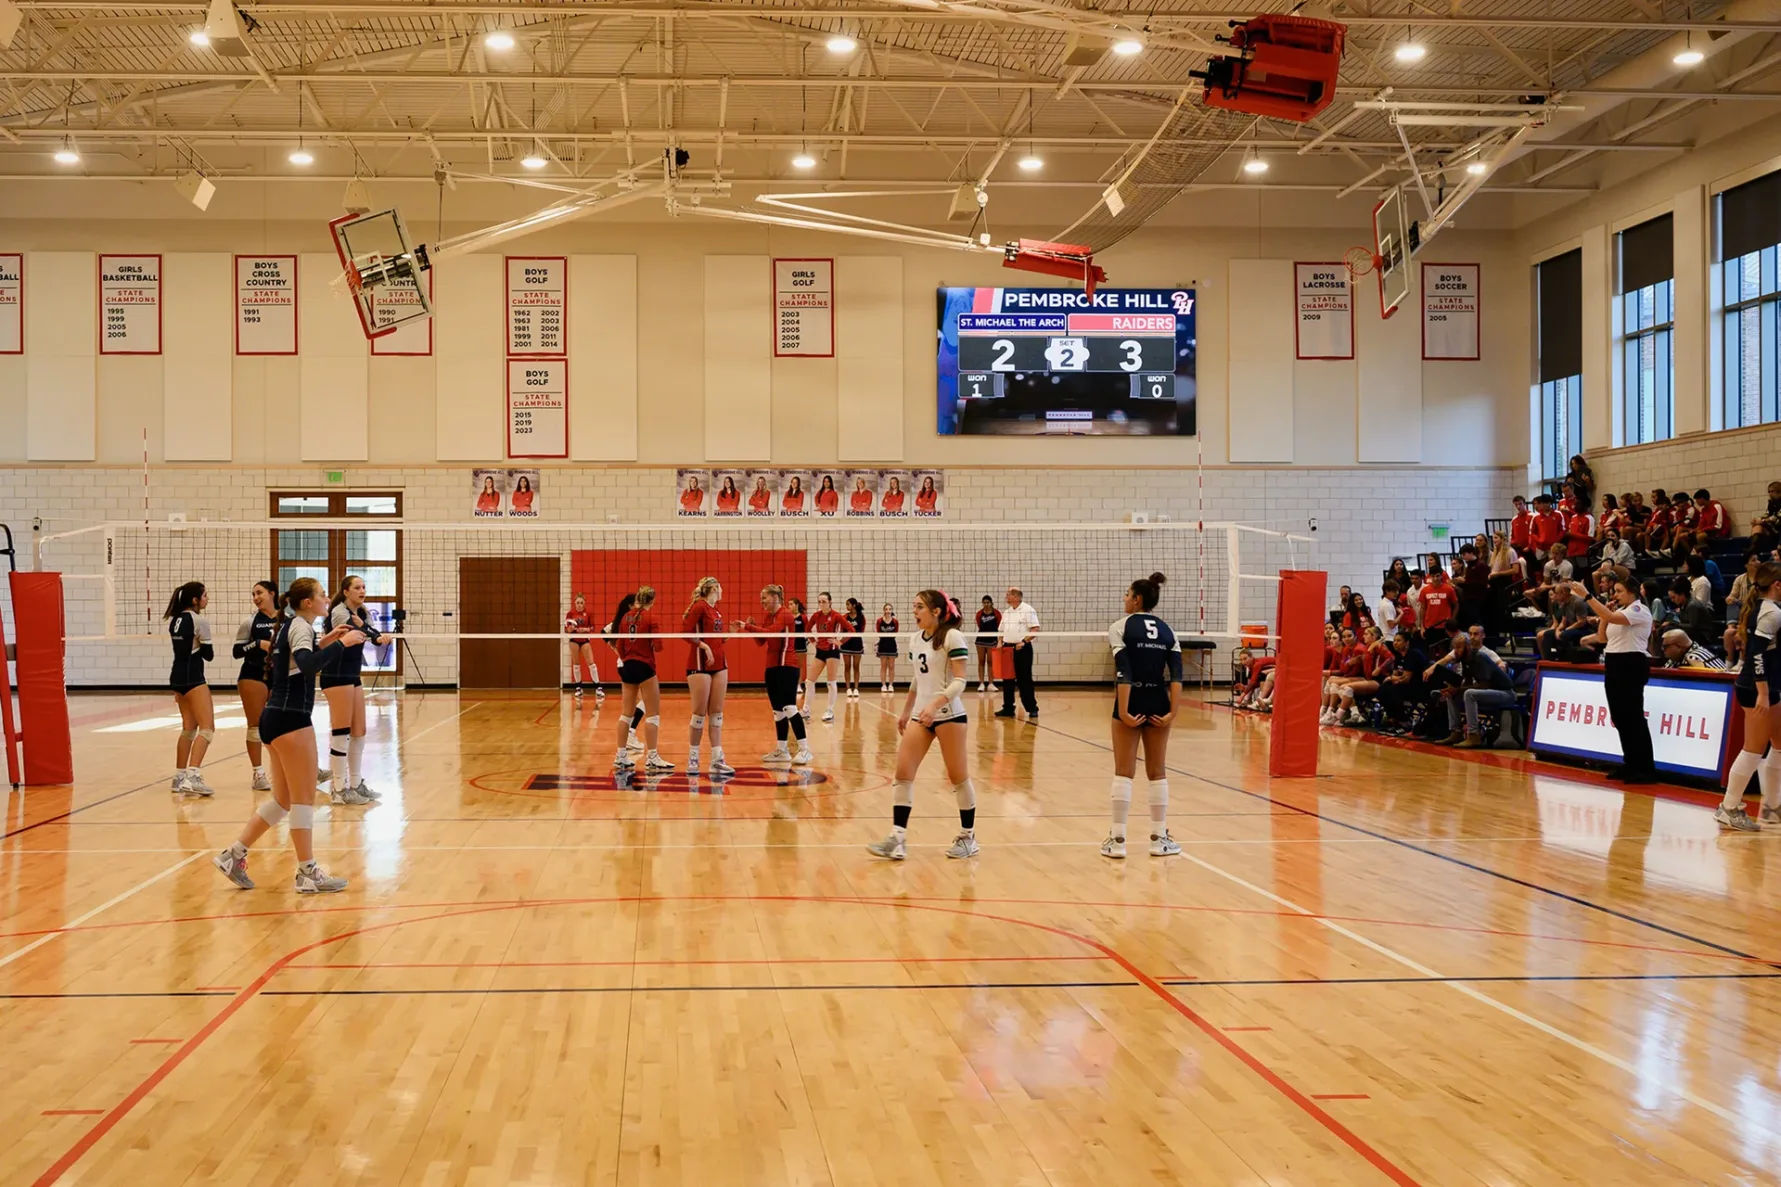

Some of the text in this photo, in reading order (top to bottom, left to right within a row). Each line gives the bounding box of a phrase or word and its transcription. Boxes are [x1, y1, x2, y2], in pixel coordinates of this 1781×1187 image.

[1125, 294, 1168, 308] HILL
[1112, 318, 1172, 329] RAIDERS
[992, 340, 1015, 371] 2
[1060, 349, 1074, 367] 2
[1119, 340, 1142, 371] 3
[972, 384, 982, 397] 1
[1152, 384, 1162, 398] 0
[1144, 620, 1158, 639] 5
[918, 653, 928, 673] 3
[1754, 654, 1764, 674] SMA
[1546, 701, 1709, 740] PEMBR HILL
